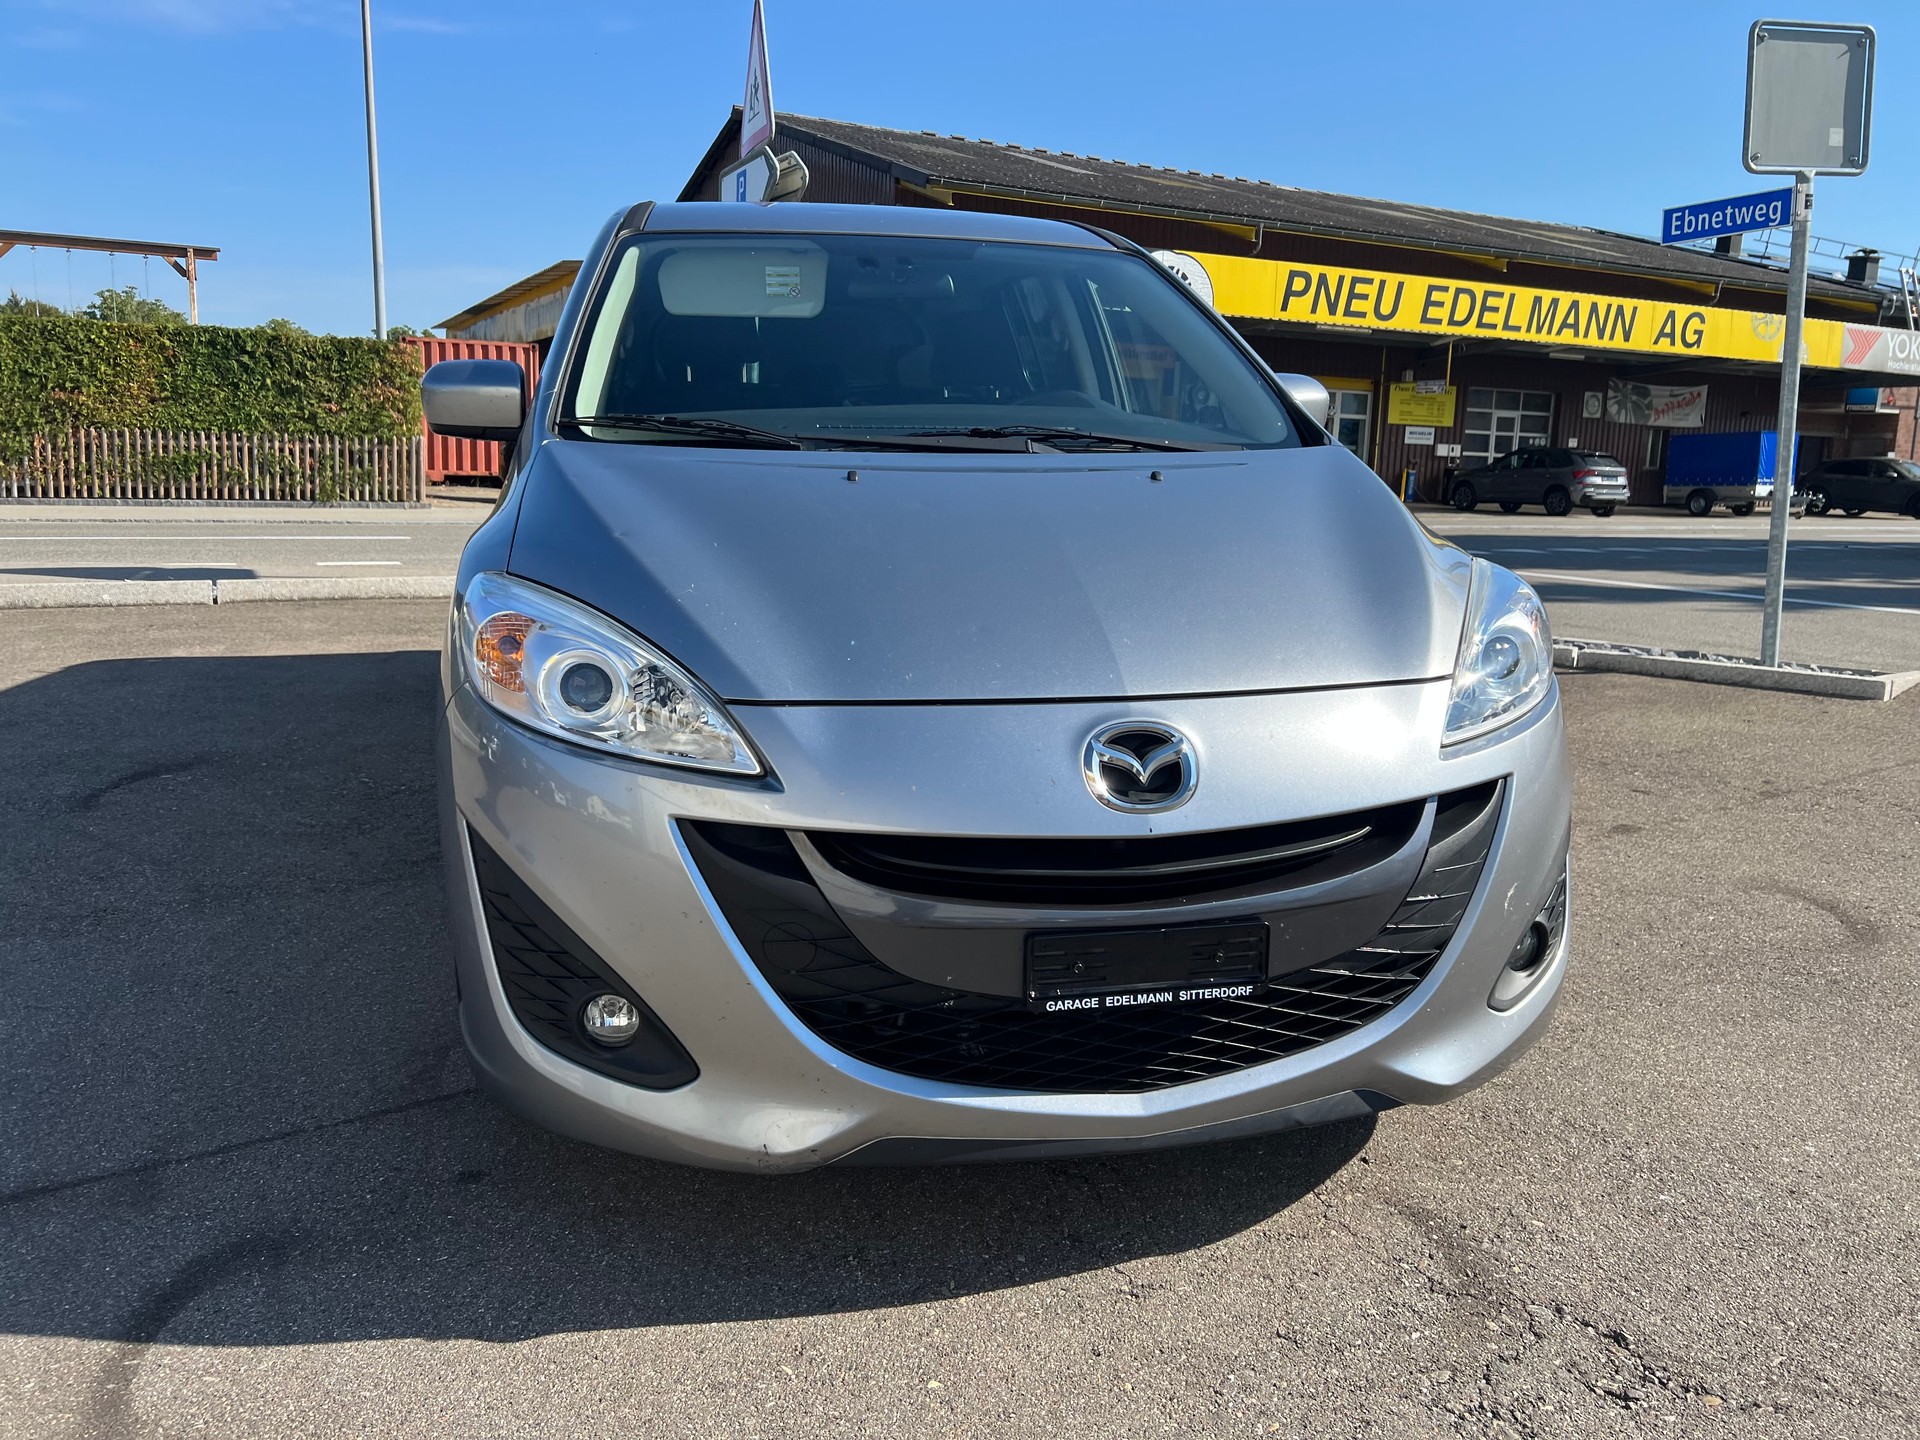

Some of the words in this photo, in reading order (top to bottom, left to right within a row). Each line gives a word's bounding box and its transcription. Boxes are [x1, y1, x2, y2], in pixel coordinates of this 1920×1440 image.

[738, 176, 745, 202] P
[1670, 200, 1783, 236] Ebnetweg
[1280, 269, 1405, 322] PNEU
[1419, 284, 1638, 343] EDELMANN
[1653, 309, 1706, 349] AG
[1887, 332, 1920, 360] YOK
[1046, 997, 1099, 1012] GARAGE
[1105, 991, 1173, 1007] EDELMANN
[1179, 985, 1254, 1001] SITTERDORF
